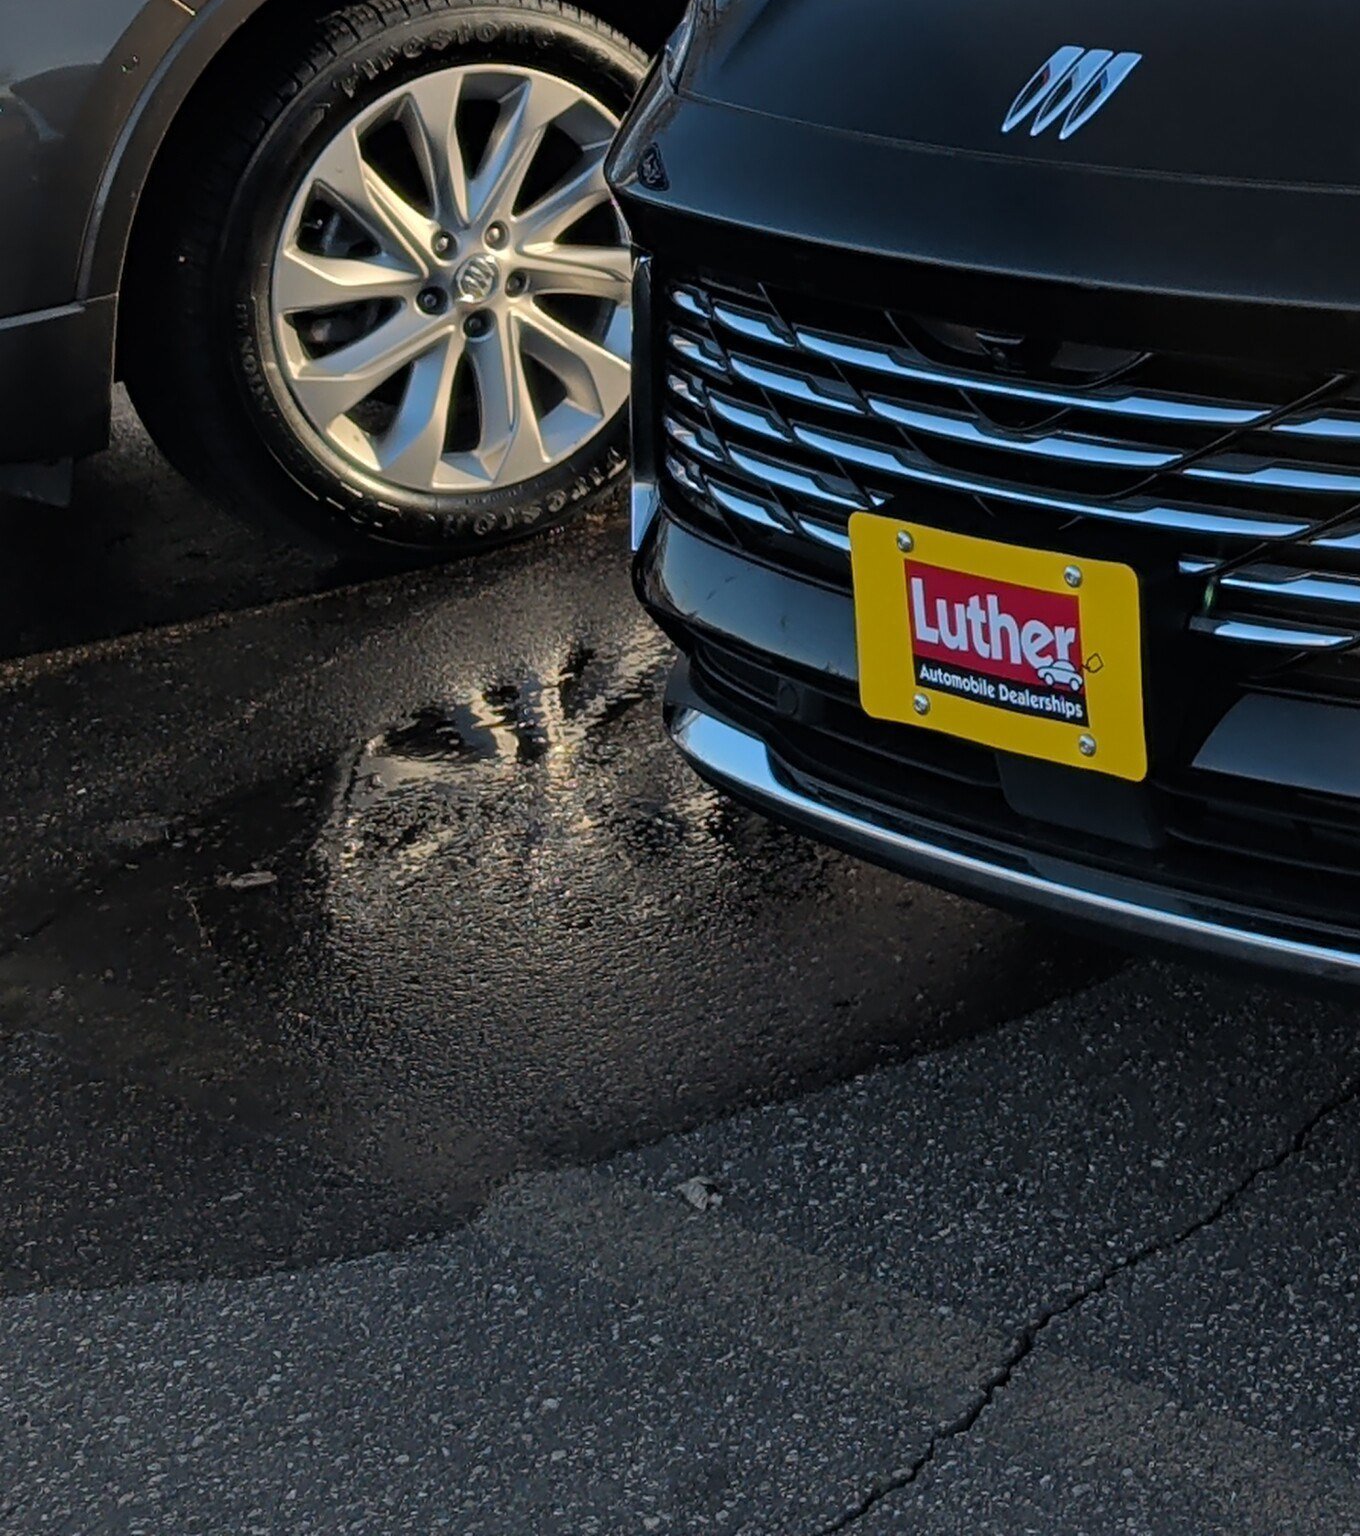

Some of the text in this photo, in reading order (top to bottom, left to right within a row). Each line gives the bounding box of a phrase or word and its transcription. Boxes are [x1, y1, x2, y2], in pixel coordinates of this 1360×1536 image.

[910, 577, 1076, 667] Luther
[919, 665, 1084, 719] Automobile Dealerships
